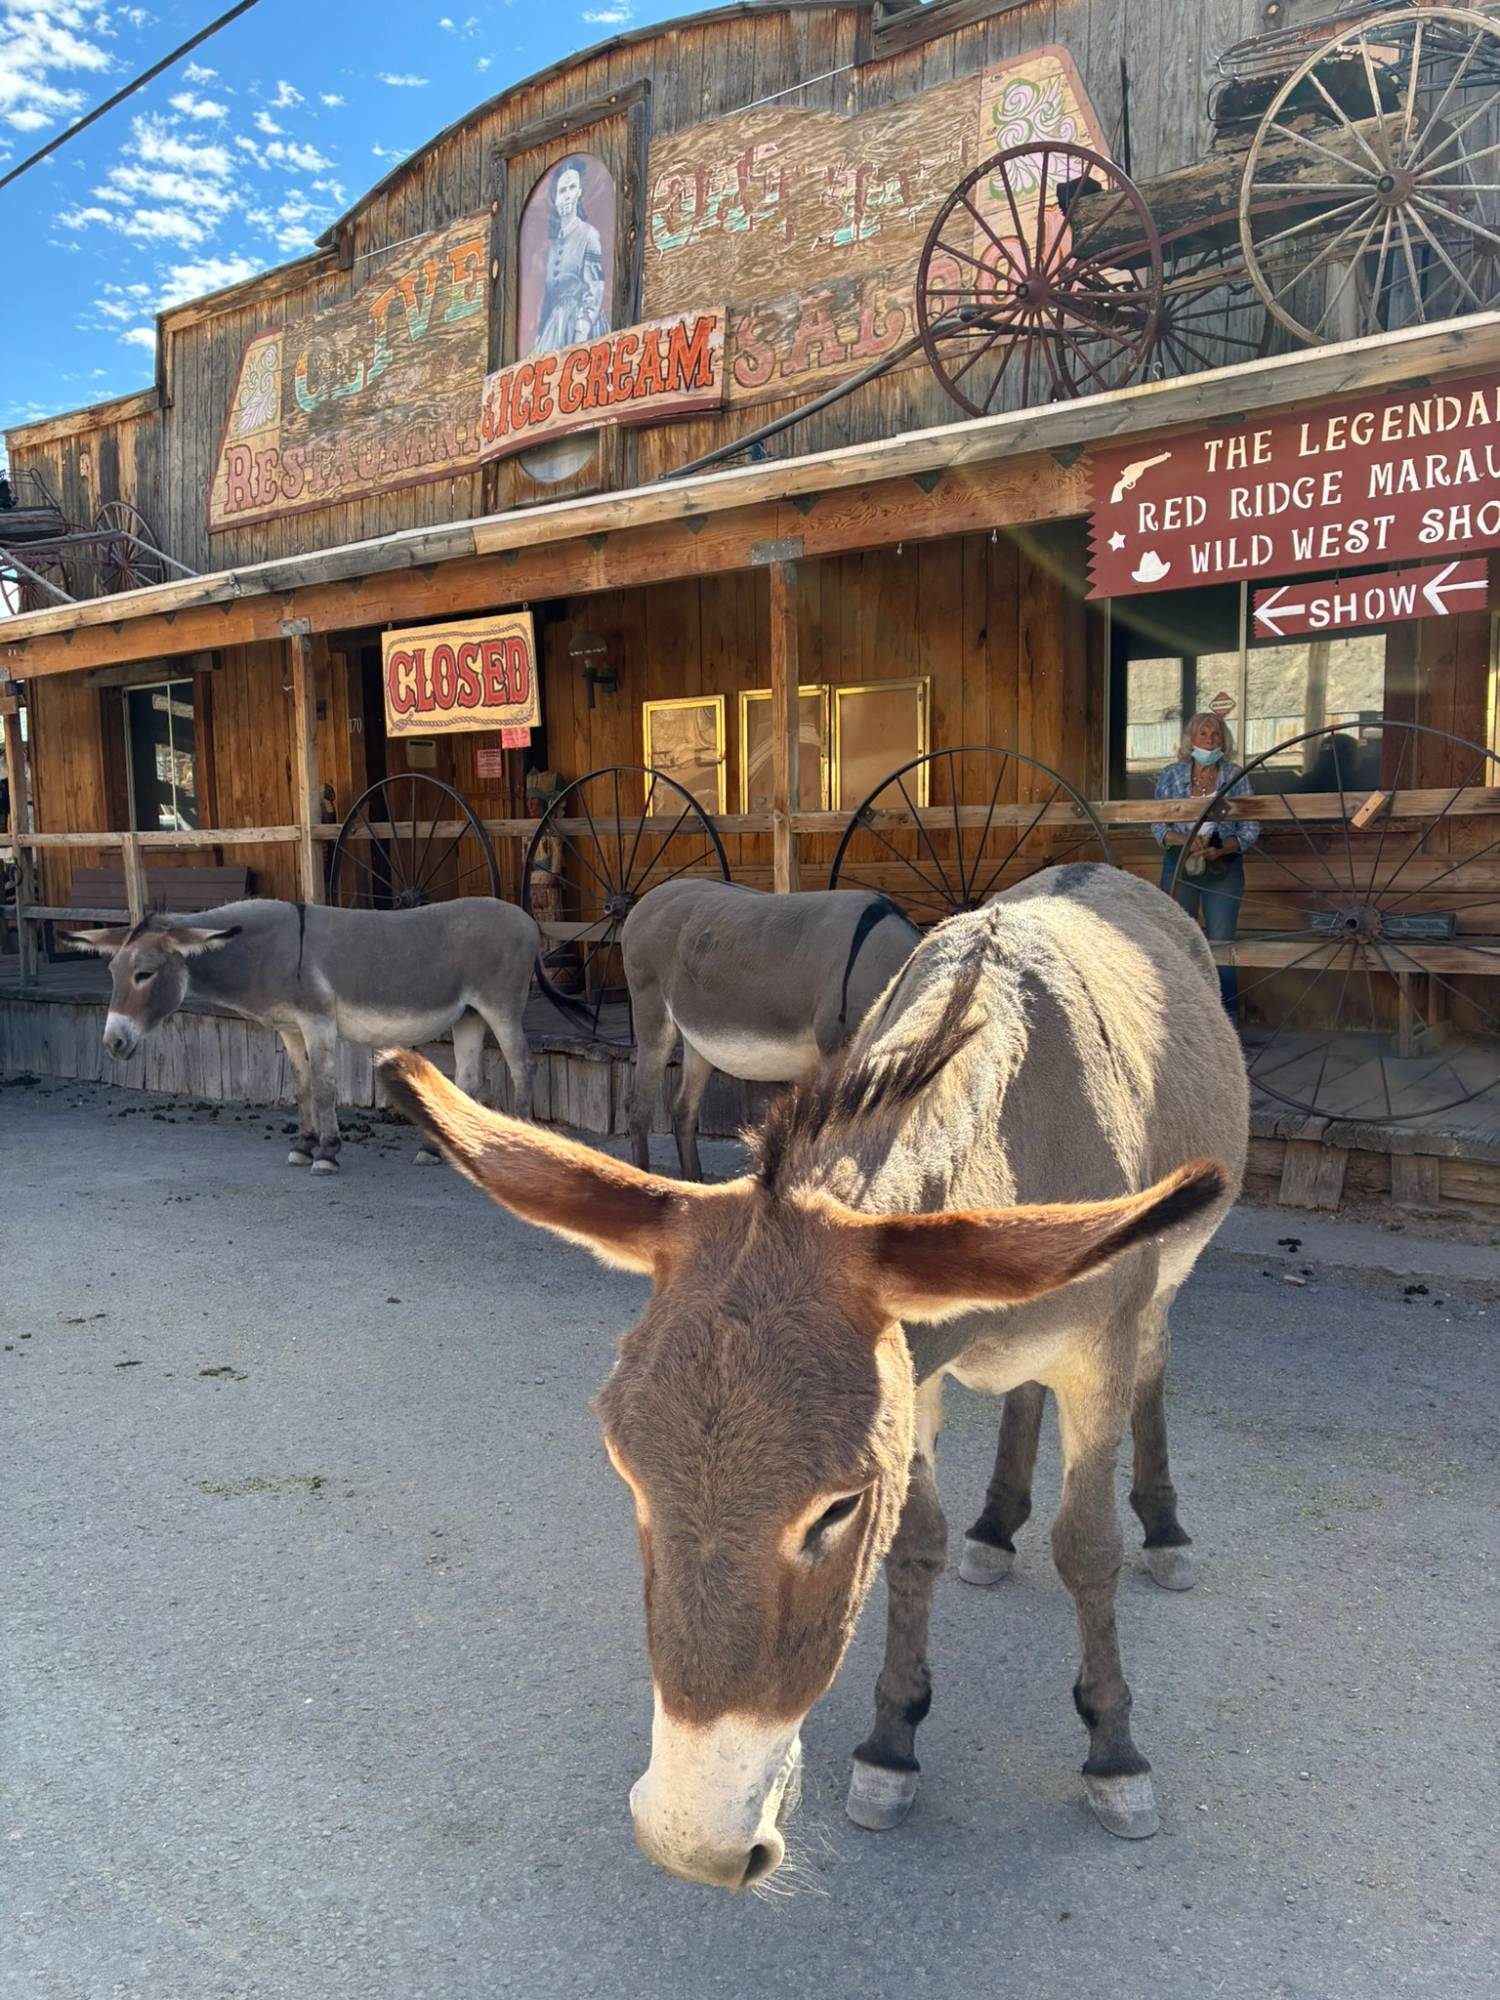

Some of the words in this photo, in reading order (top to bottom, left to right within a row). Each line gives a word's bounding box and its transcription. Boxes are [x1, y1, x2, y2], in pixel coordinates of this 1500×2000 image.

[496, 356, 558, 439] ICE
[557, 315, 719, 415] CREAM
[1205, 429, 1273, 473] THE
[1298, 386, 1500, 457] LEGENDA
[1137, 495, 1207, 533] RED
[1229, 470, 1344, 520] RIDGE
[1189, 535, 1274, 574] WILD
[1291, 515, 1396, 561] WEST
[1308, 585, 1417, 628] SHOW
[388, 636, 530, 714] CLOSED
